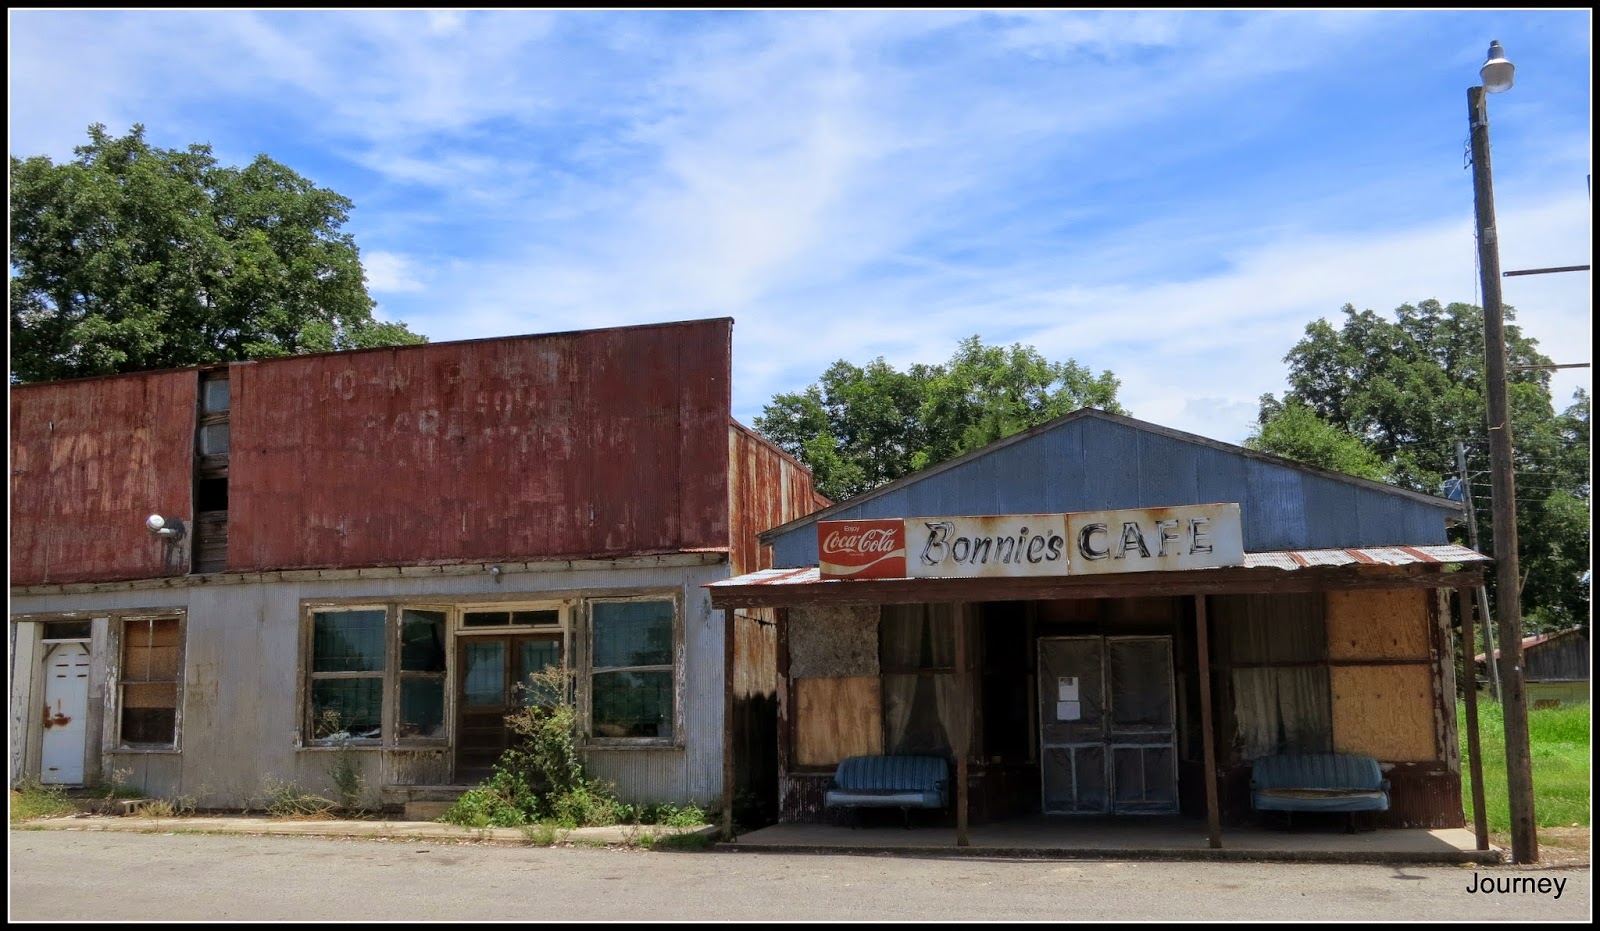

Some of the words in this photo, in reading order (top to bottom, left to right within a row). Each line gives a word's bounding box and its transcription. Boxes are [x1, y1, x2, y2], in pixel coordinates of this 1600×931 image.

[822, 528, 898, 554] Coca-Cola
[843, 525, 860, 533] Enjoy
[920, 521, 1064, 566] Bonnie's
[1077, 517, 1213, 561] CAFE
